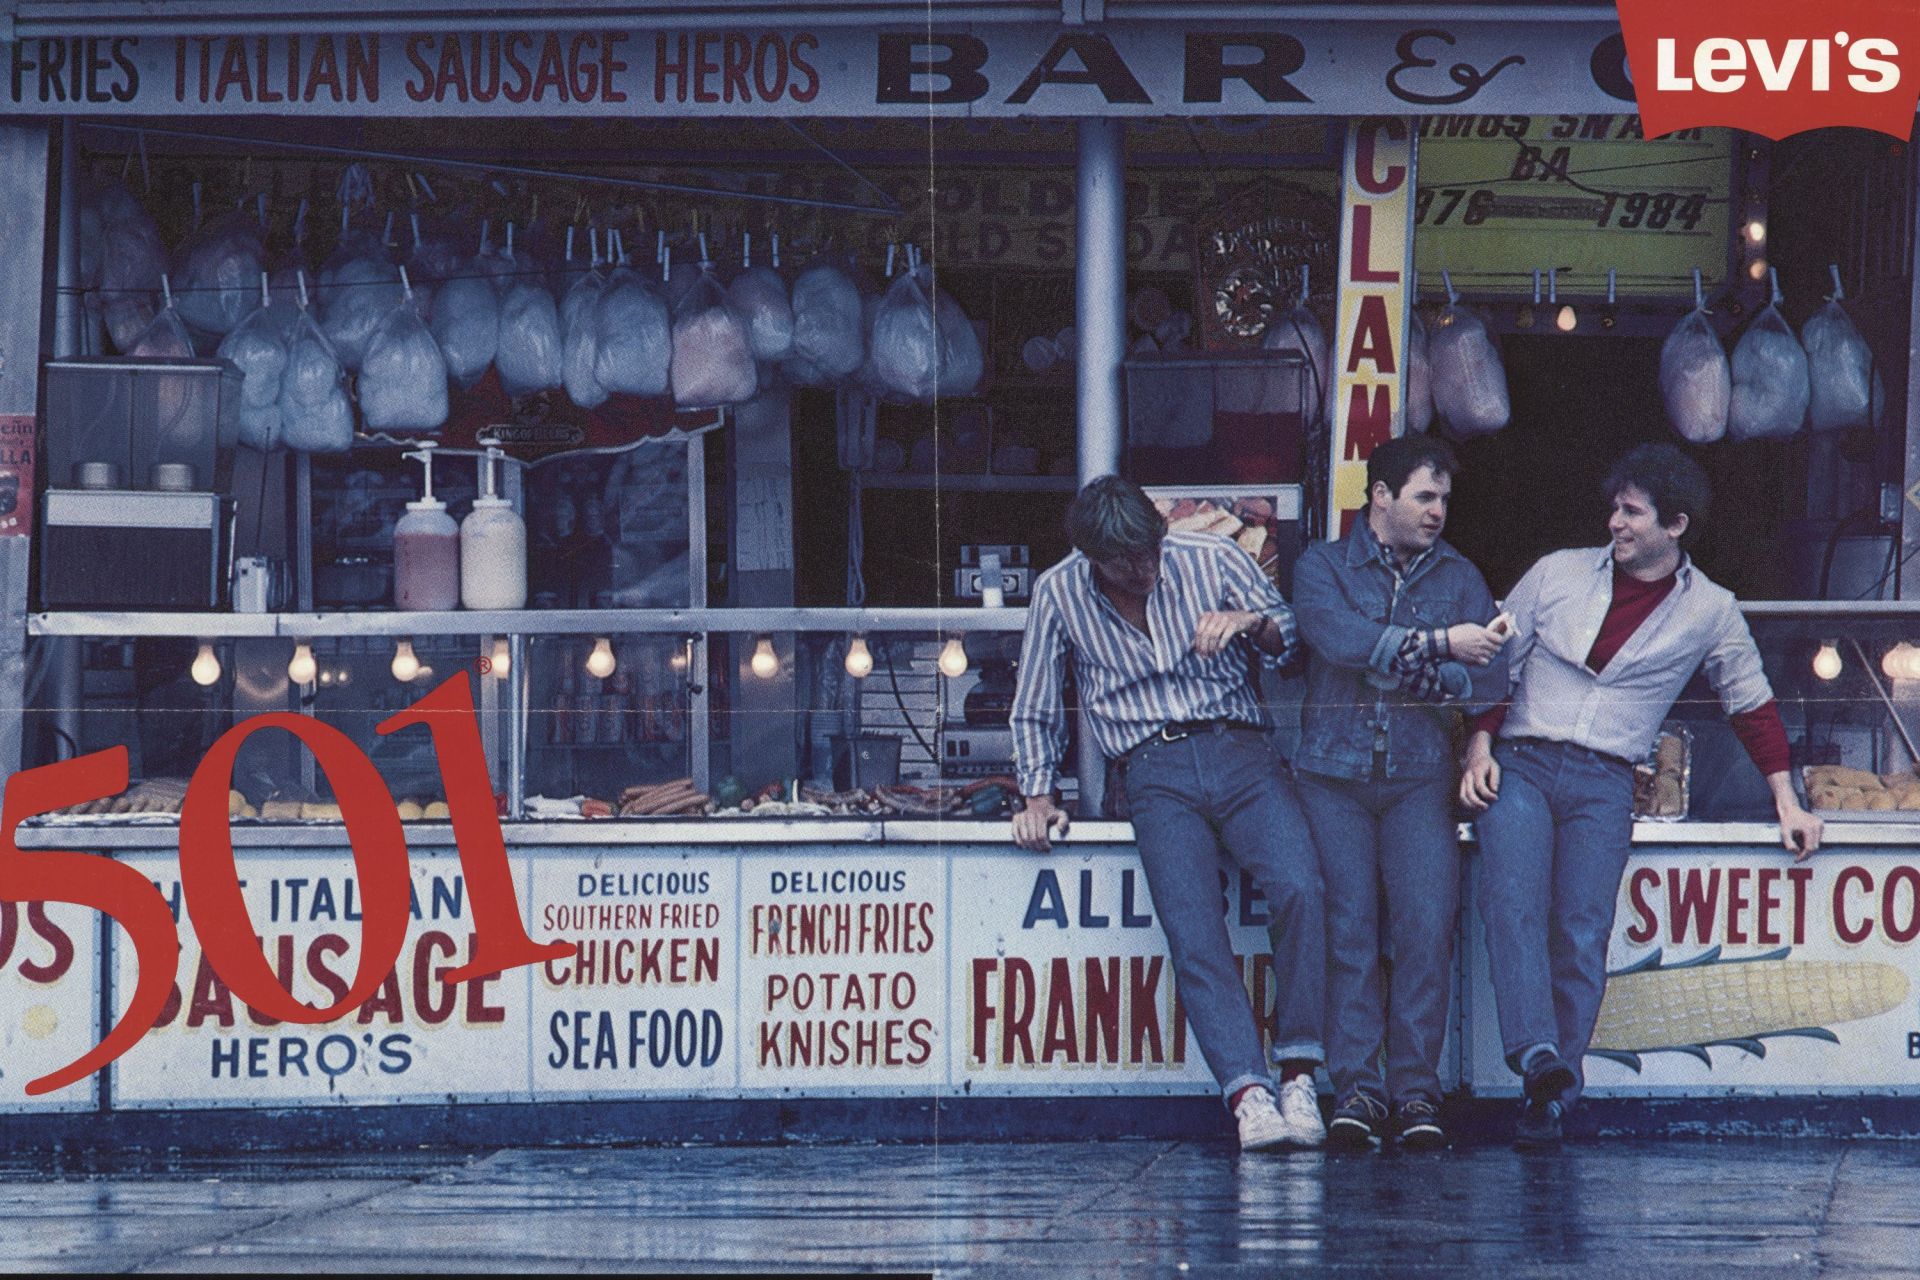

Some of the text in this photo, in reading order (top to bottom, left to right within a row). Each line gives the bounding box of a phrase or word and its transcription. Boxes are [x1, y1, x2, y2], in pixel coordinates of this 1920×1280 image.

[10, 32, 821, 104] FRIES ITALIAN SAUSAGE HEROS
[876, 32, 1315, 104] BAR
[1385, 28, 1526, 105] &
[1597, 192, 1707, 230] 1984
[1036, 221, 1196, 262] SDA
[270, 876, 463, 922] ITALN
[578, 872, 710, 896] DELICIOUS
[771, 871, 907, 894] DELICIOUS
[1022, 869, 1153, 929] ALL
[543, 903, 720, 931] SOUTHERN FRIED
[752, 902, 934, 955] FRENCH FRIES
[1626, 867, 1813, 945] SWEET
[544, 937, 720, 986] CHICKEN
[767, 972, 916, 1012] POTATO
[211, 1032, 413, 1078] HERO'S
[759, 1018, 933, 1068] KNISHES
